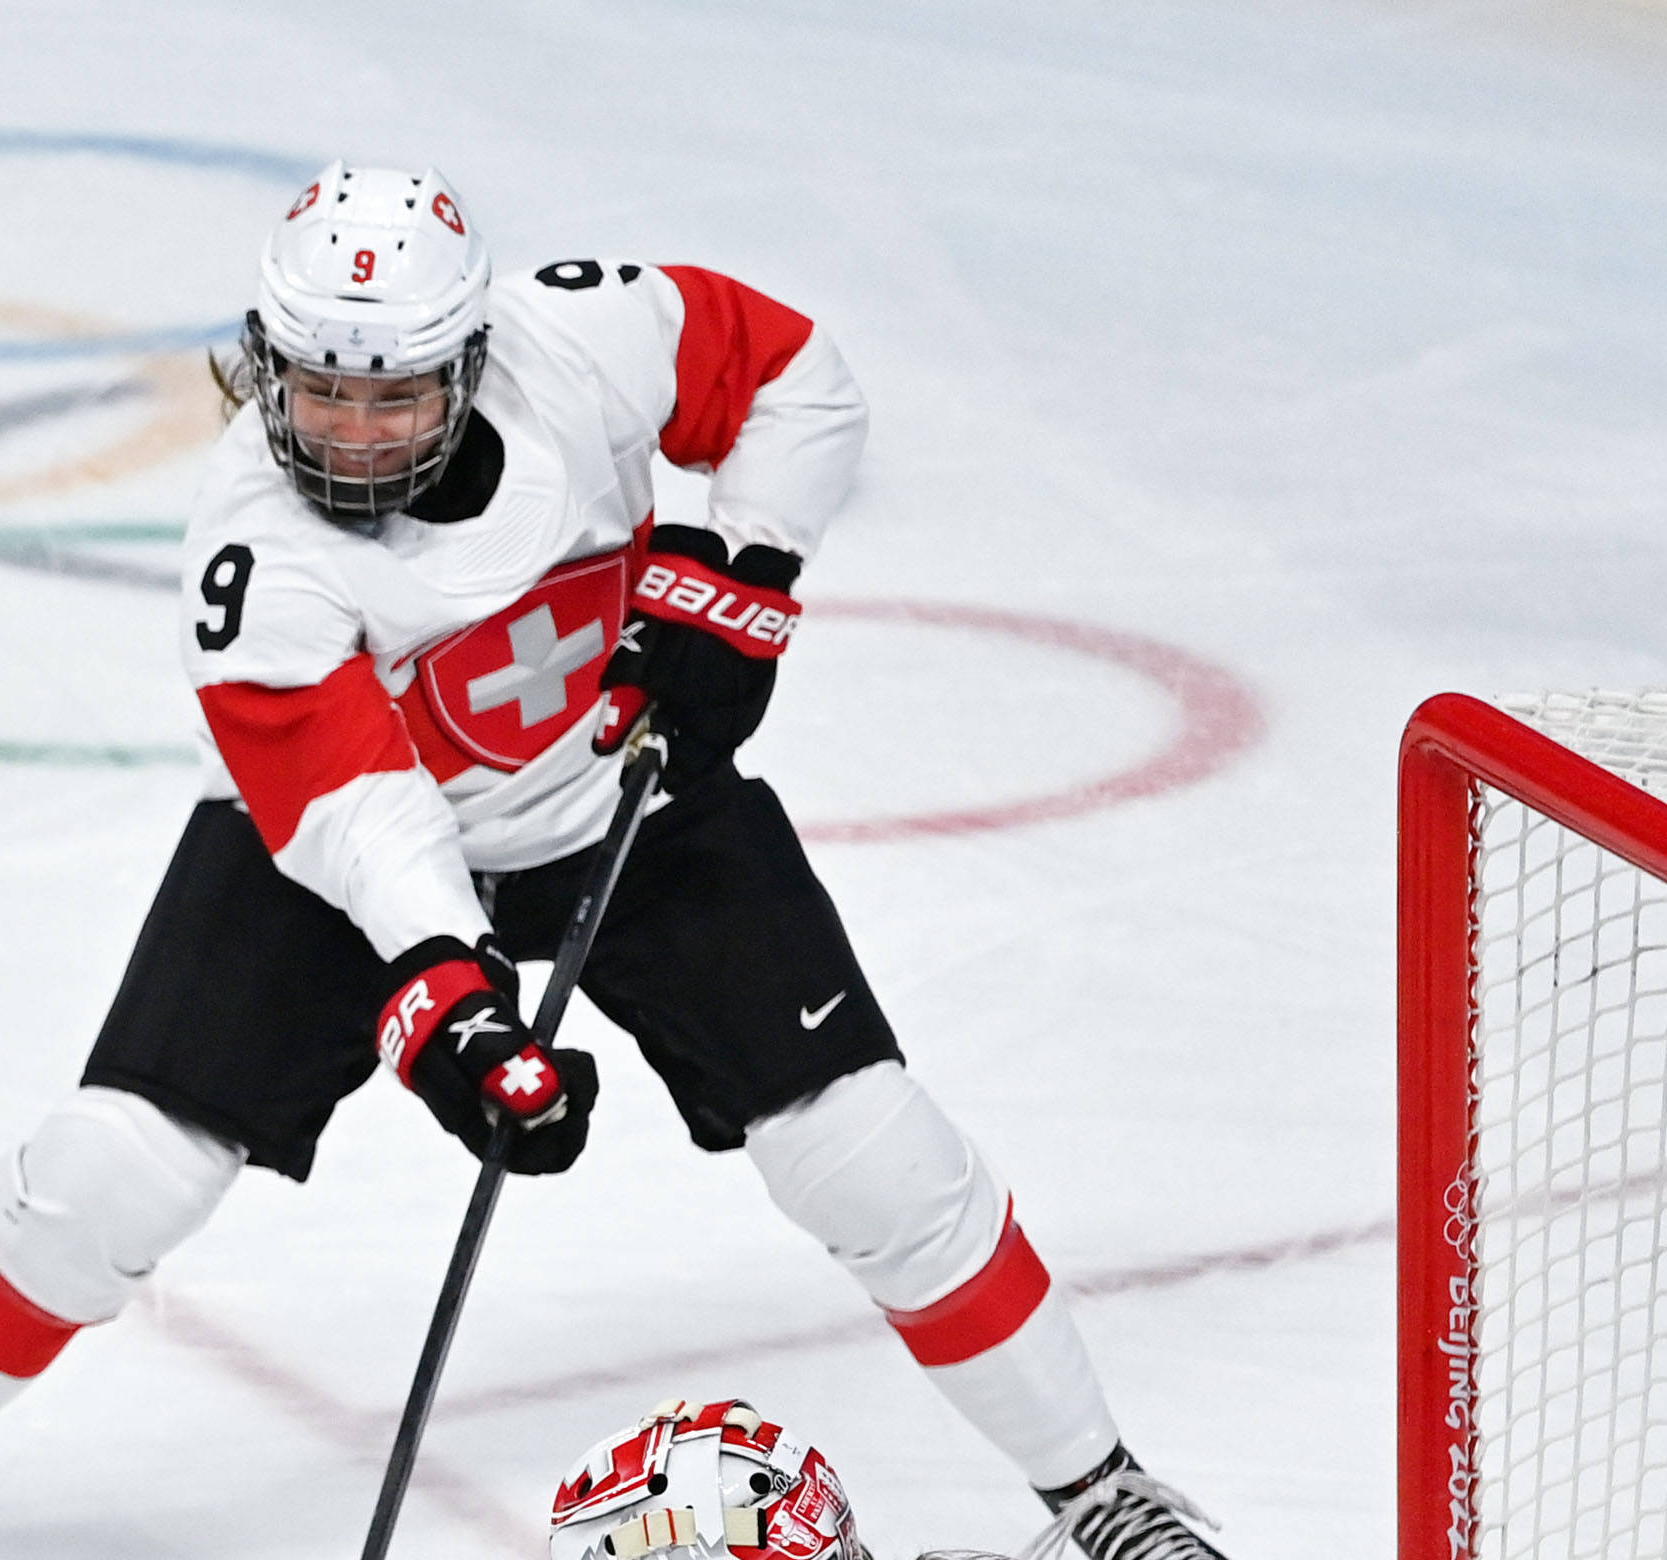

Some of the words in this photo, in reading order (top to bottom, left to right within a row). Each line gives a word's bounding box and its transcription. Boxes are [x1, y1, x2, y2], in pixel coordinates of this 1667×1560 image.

[352, 249, 376, 284] 9
[195, 544, 255, 652] 9
[634, 564, 805, 647] BAUER
